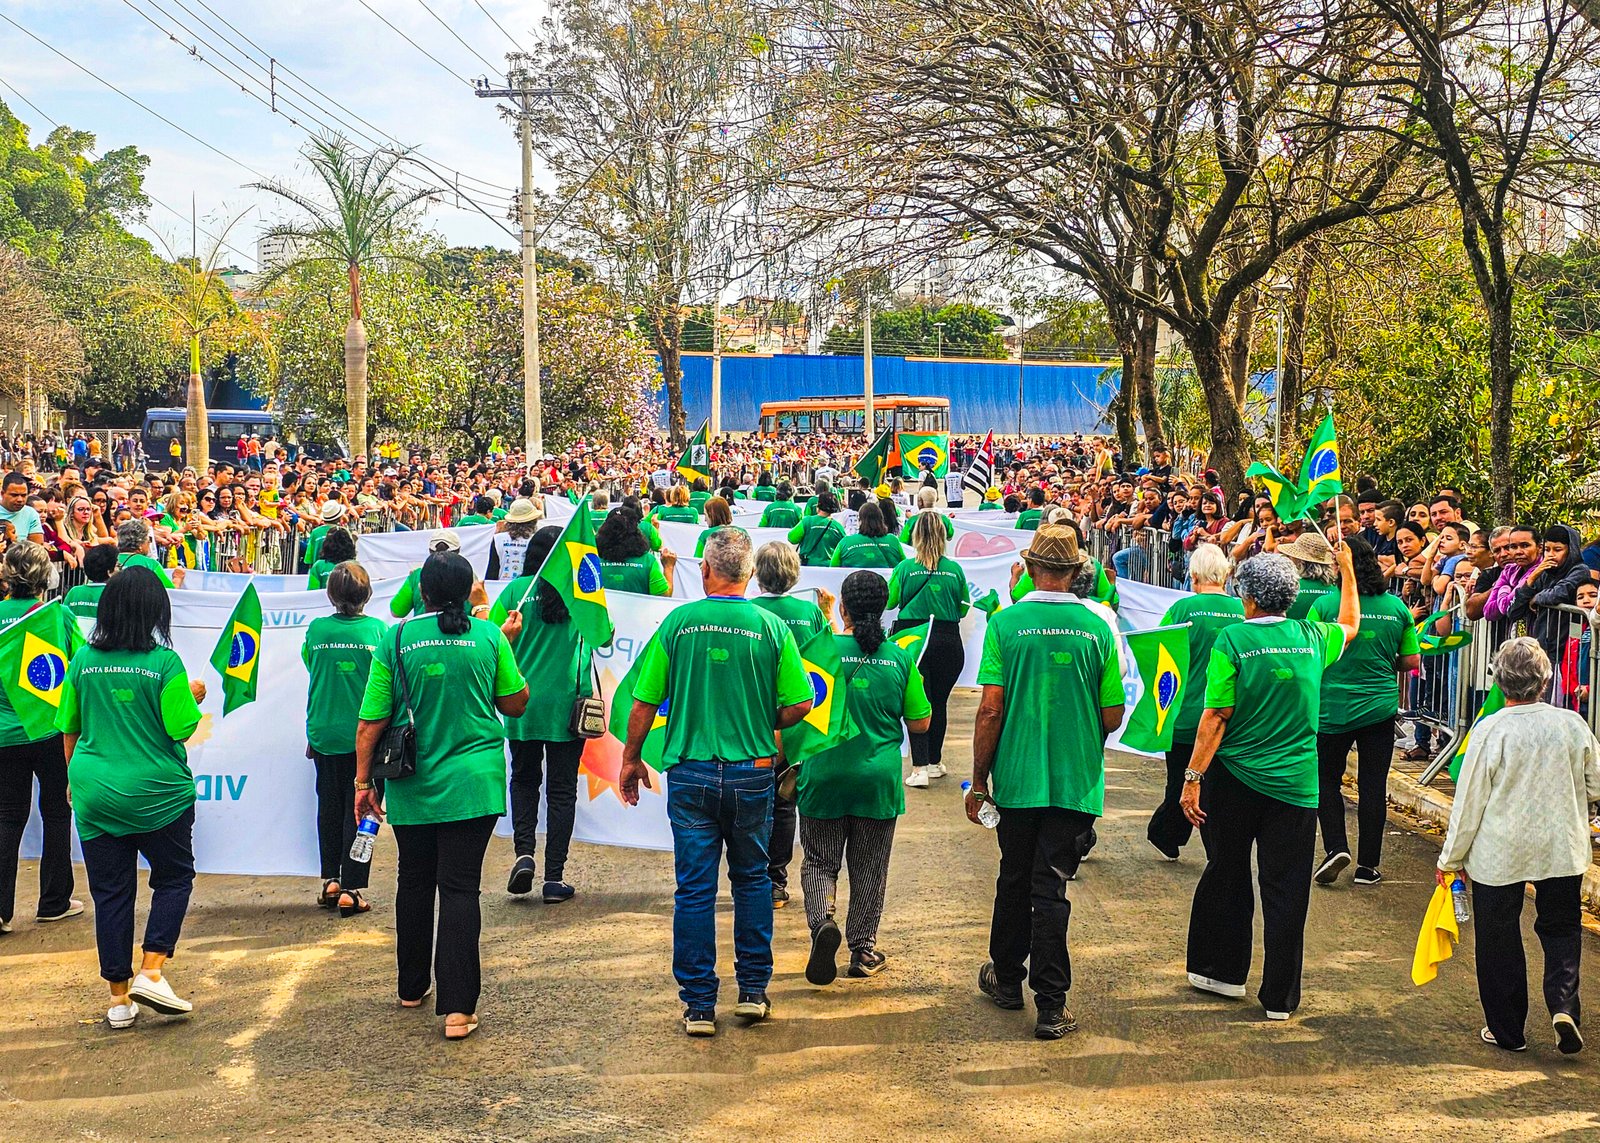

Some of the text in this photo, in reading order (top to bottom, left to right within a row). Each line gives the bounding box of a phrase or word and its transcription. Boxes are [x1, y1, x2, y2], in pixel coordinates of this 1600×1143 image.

[700, 623, 732, 634] BÁRBARA
[733, 627, 763, 641] D'OESTE
[1017, 628, 1041, 637] SANTA
[1042, 627, 1075, 636] BÁRBARA
[412, 640, 445, 650] BÁRBARA
[445, 639, 477, 648] D'OESTE
[1239, 649, 1261, 660] SANTA
[1261, 646, 1292, 655] BÁRBARA
[81, 666, 103, 675] SANTA
[103, 664, 134, 674] BÁRBARA
